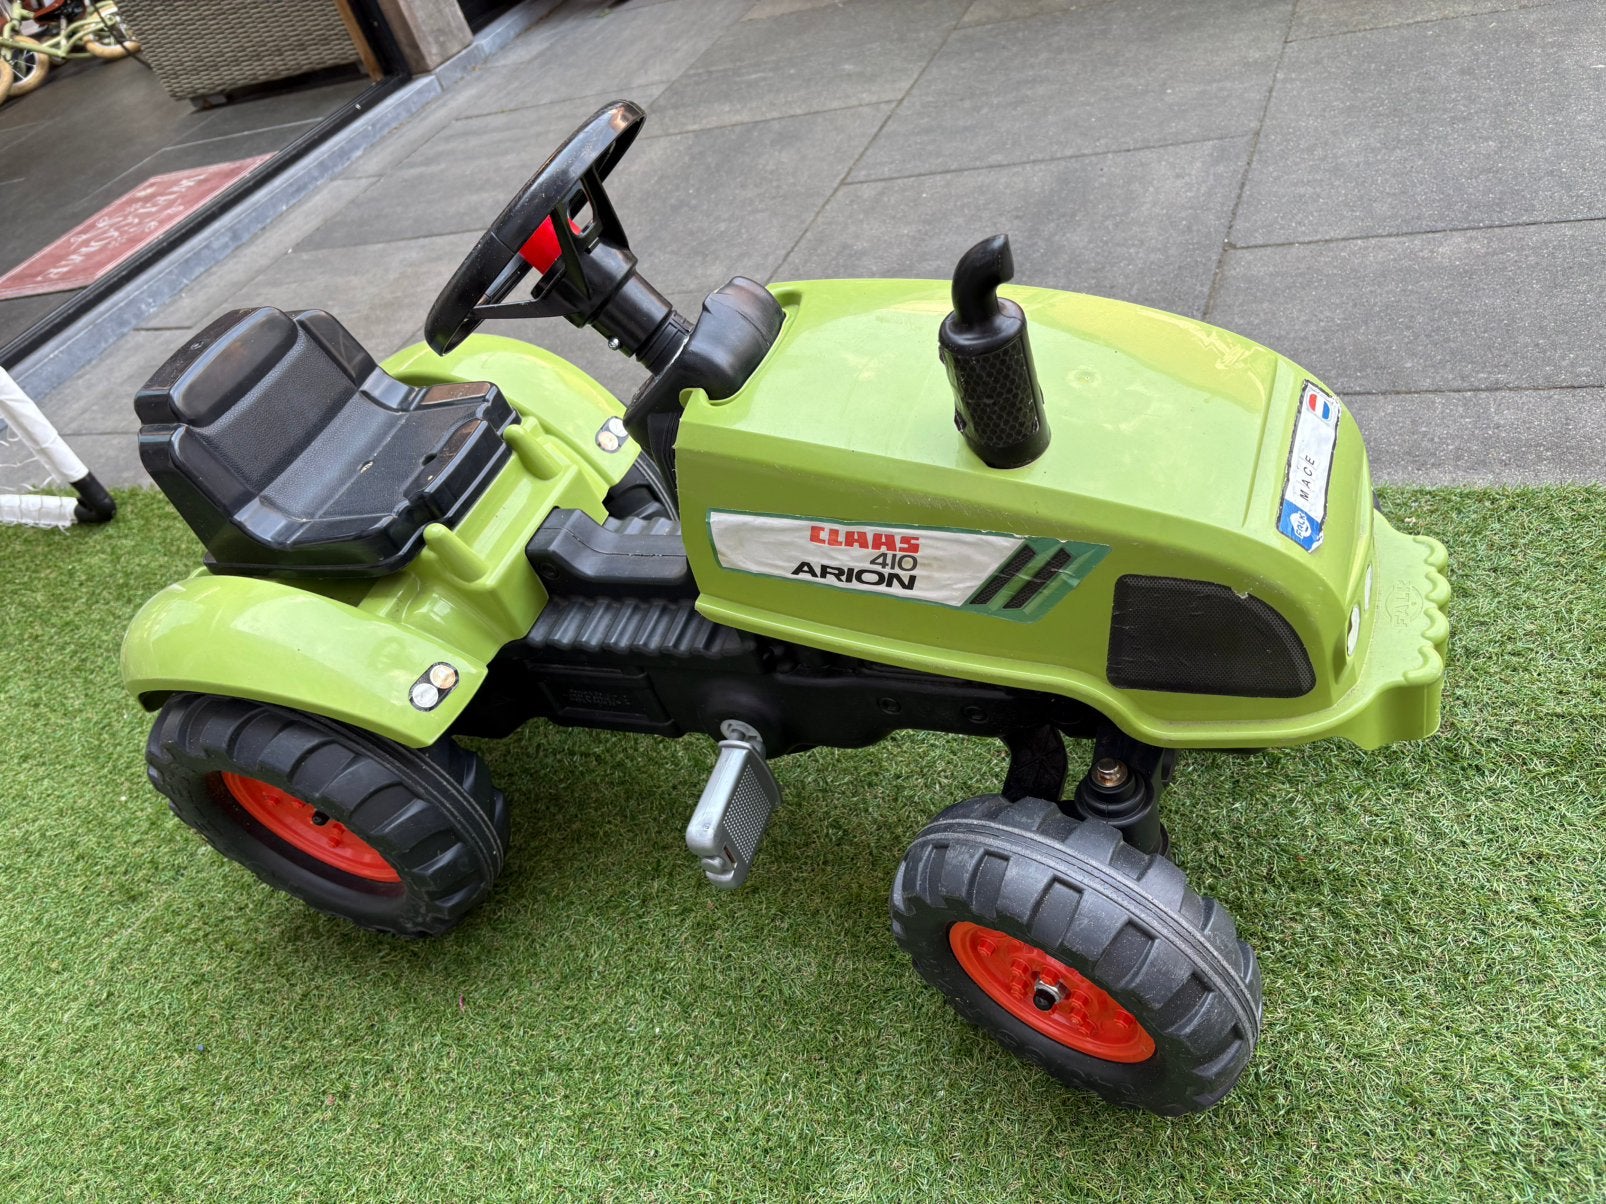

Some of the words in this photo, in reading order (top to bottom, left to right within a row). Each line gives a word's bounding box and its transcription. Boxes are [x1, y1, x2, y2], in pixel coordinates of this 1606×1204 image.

[1299, 455, 1315, 501] MACE
[1295, 512, 1306, 538] FALK
[810, 526, 919, 553] CLAAS
[791, 561, 917, 590] ARION
[869, 553, 918, 571] 410
